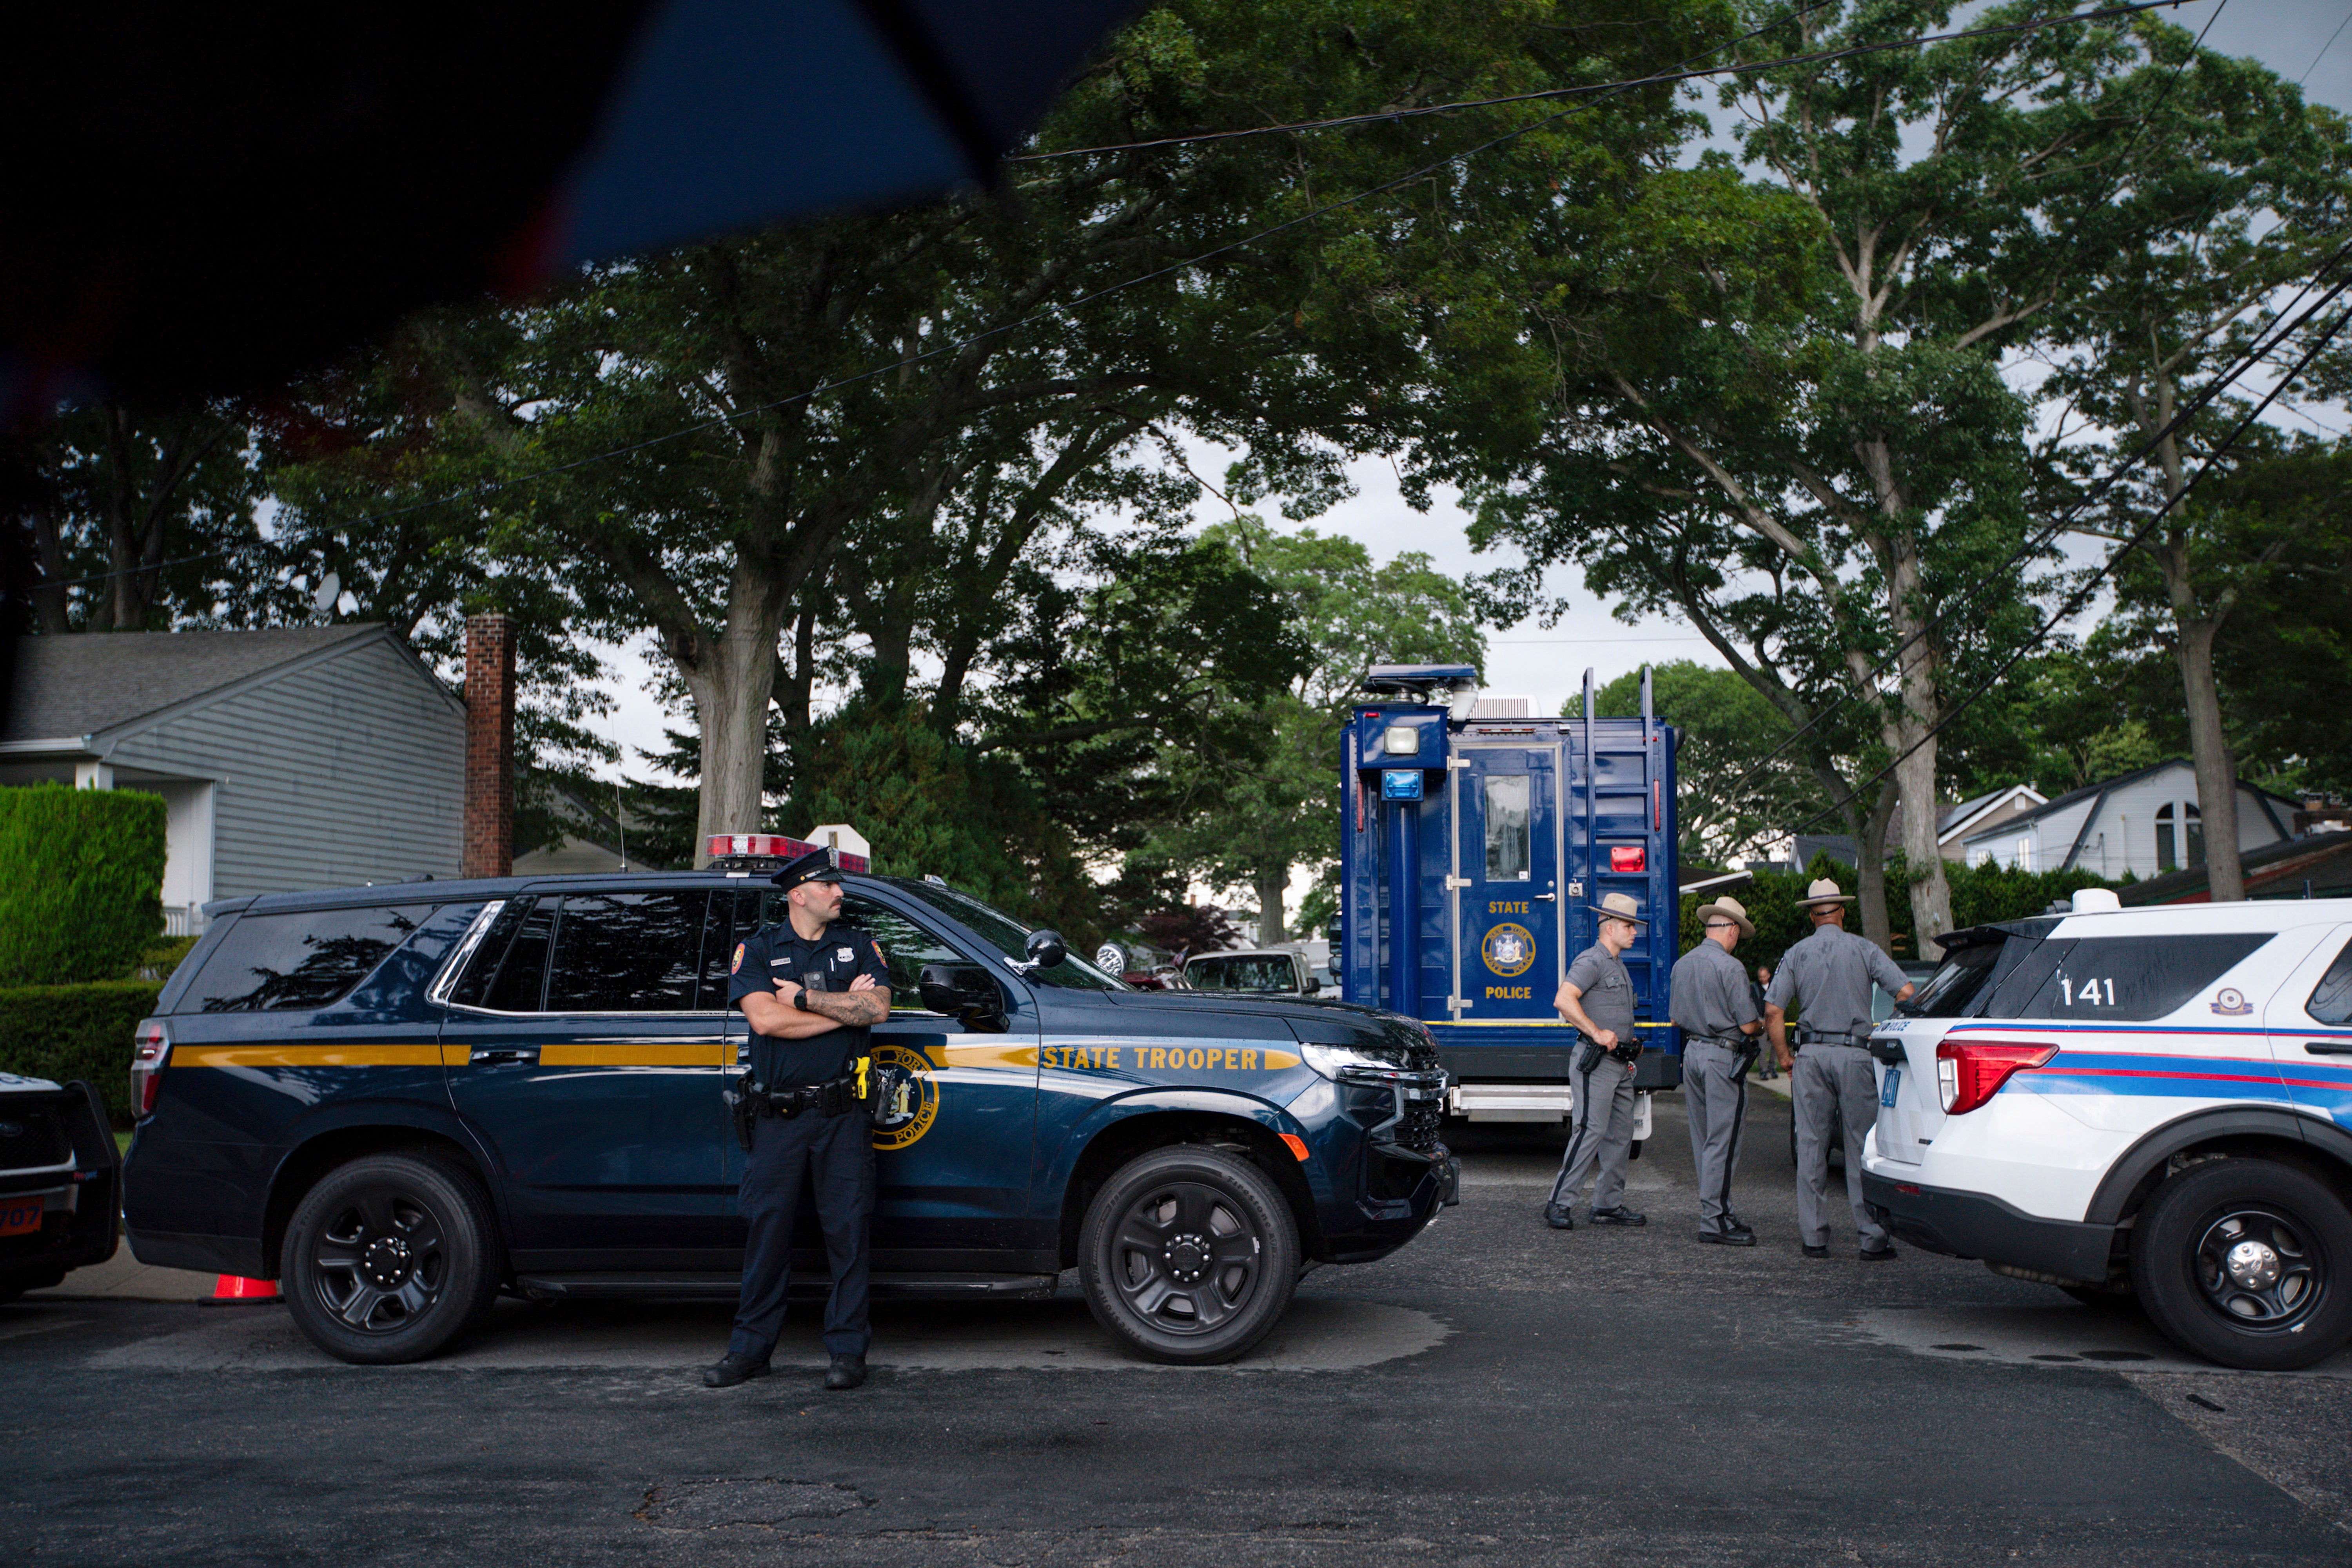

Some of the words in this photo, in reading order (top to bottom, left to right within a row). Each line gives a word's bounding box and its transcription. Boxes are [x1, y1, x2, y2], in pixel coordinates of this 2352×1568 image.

[1488, 901, 1529, 914] STATE
[1485, 986, 1532, 999] POLICE
[2061, 978, 2115, 1006] 141
[1043, 1046, 1120, 1069] STATE
[1134, 1048, 1258, 1070] TROOPER
[894, 1101, 933, 1144] POLICE
